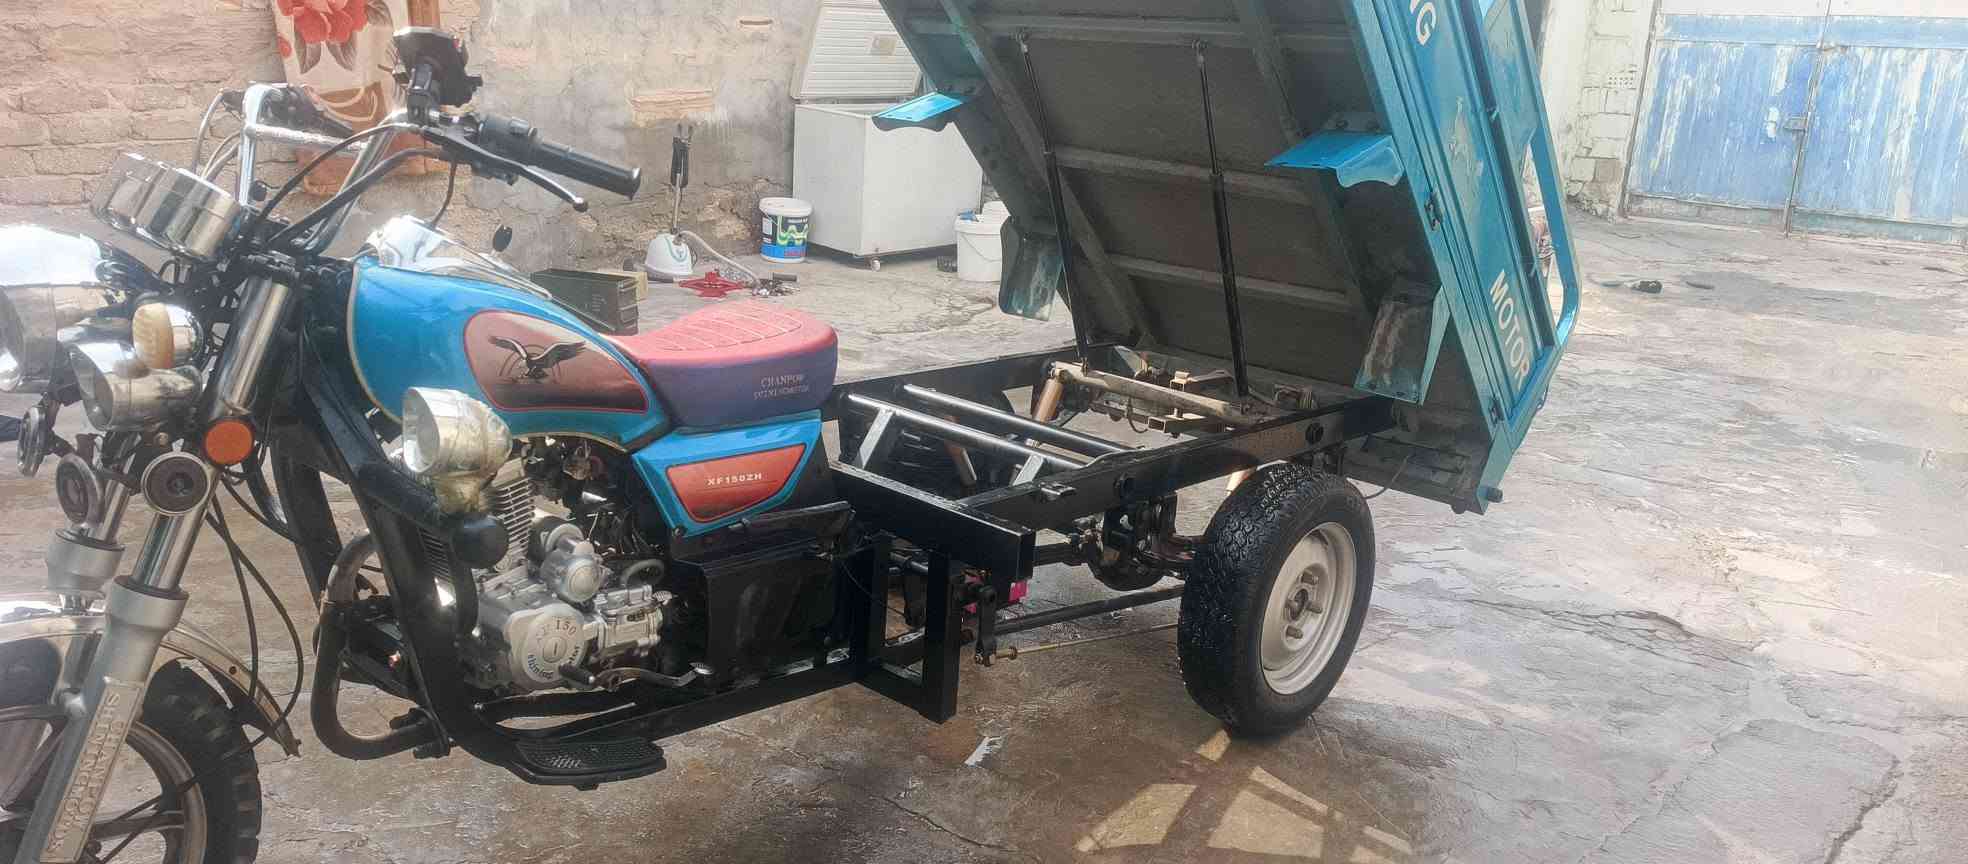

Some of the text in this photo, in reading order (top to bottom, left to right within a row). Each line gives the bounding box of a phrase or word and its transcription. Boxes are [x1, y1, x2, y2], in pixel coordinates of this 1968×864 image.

[1489, 269, 1530, 391] MOTOR
[707, 472, 763, 486] XF150ZH
[555, 618, 577, 636] 150
